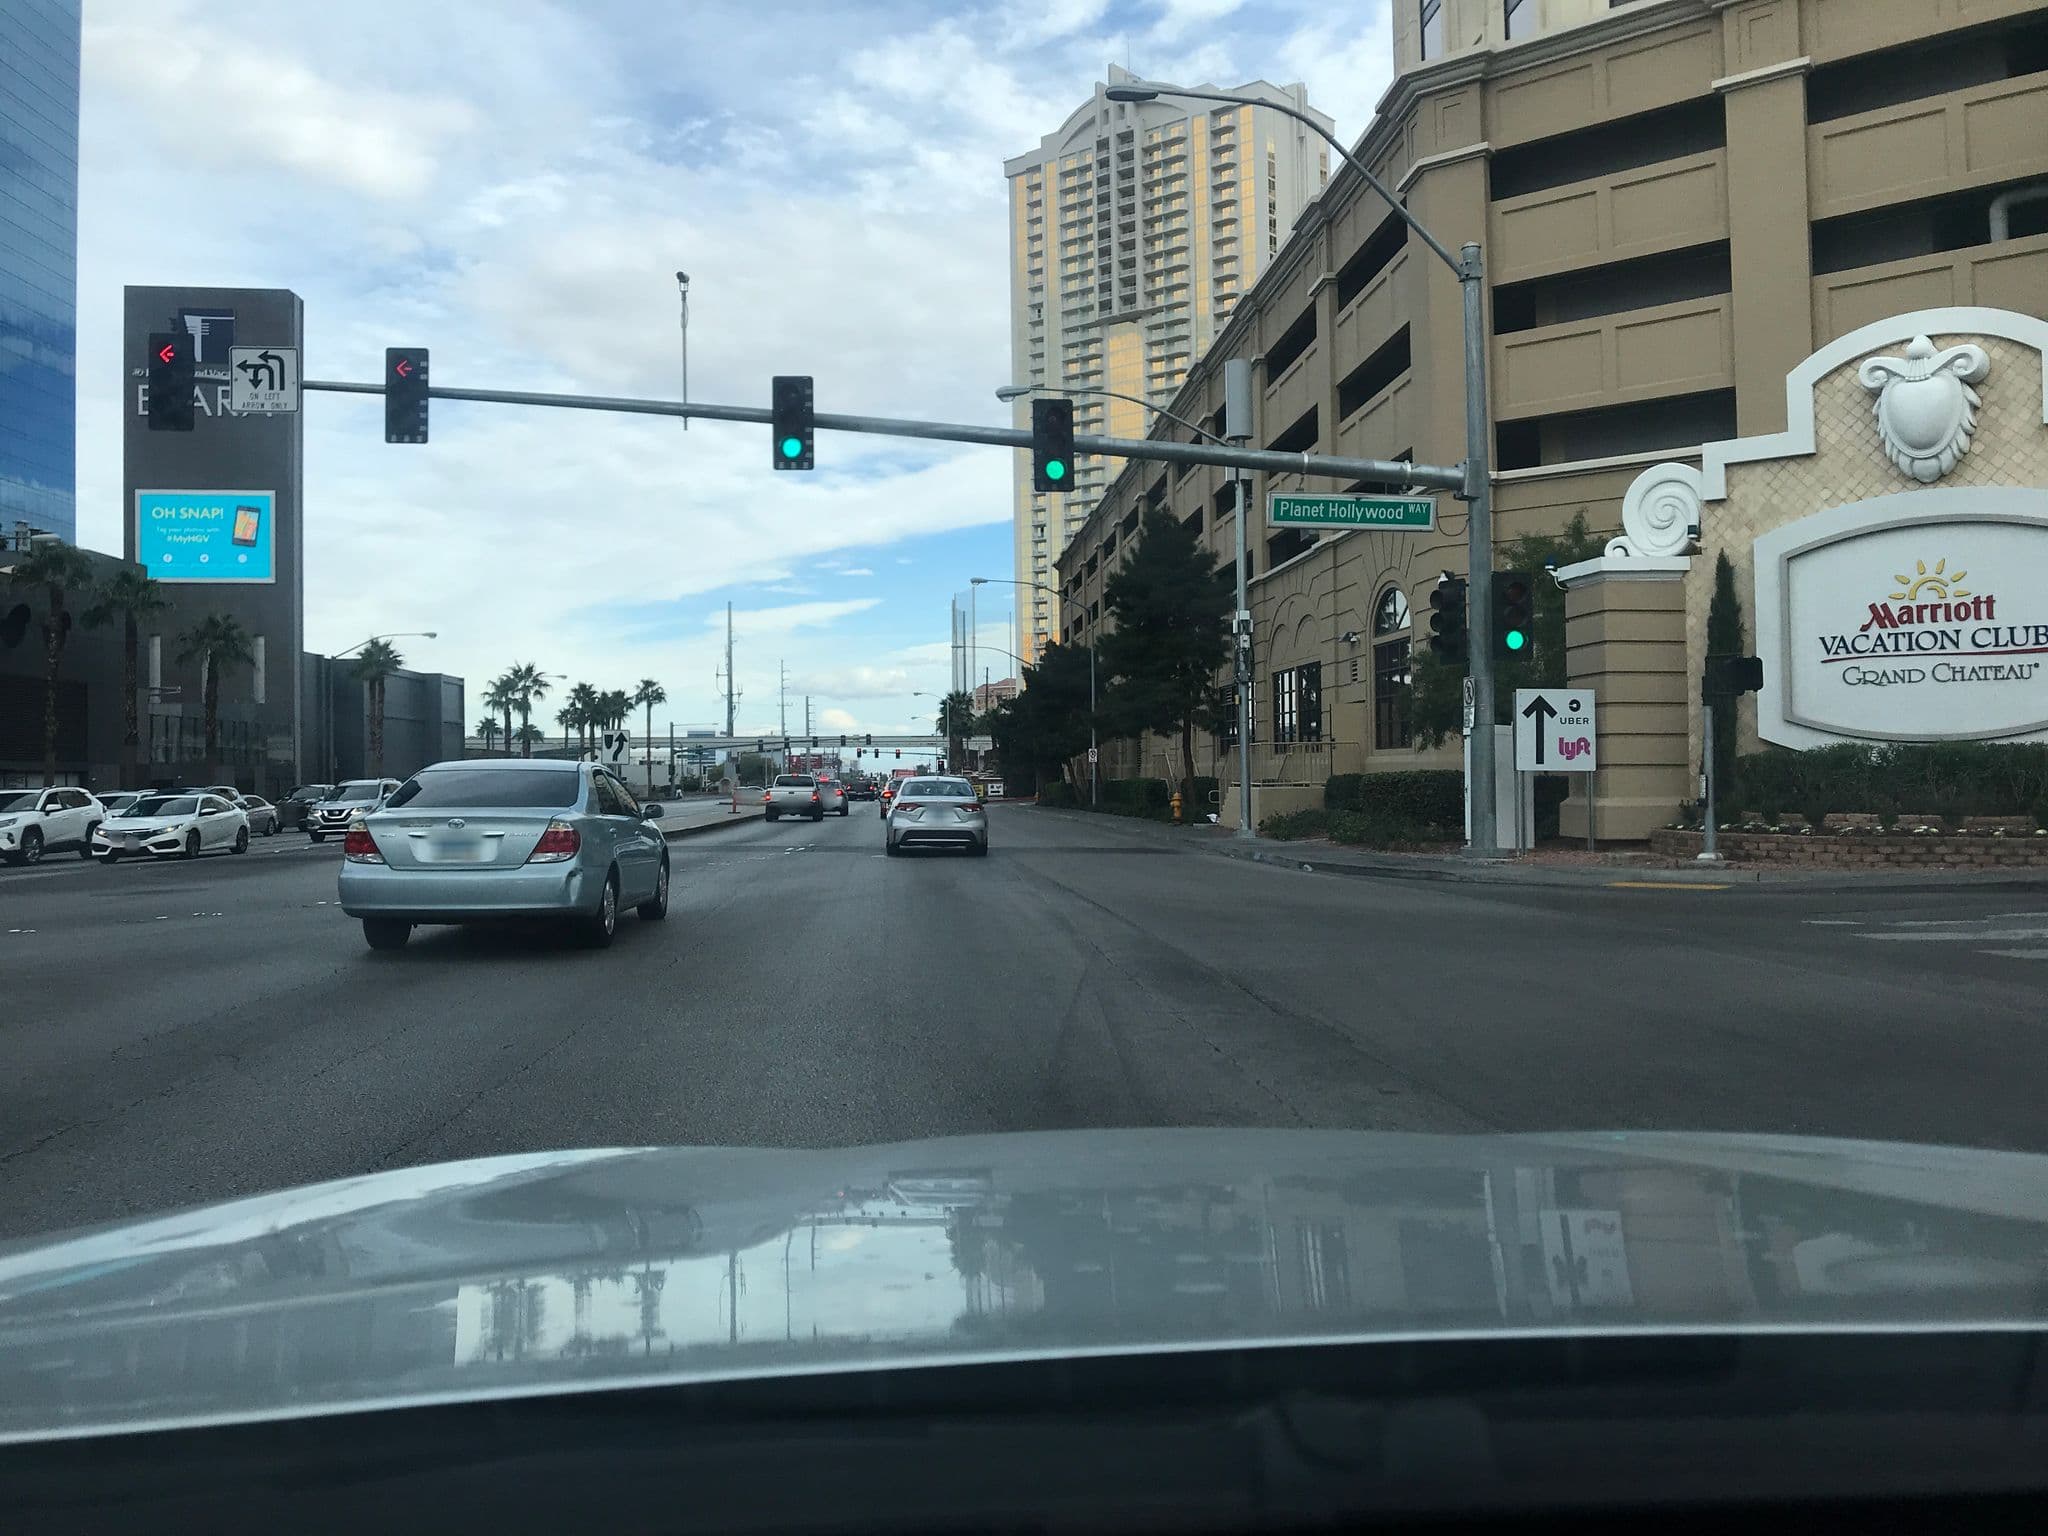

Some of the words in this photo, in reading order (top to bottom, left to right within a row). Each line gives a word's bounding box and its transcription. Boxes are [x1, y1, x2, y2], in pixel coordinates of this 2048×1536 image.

[242, 401, 265, 409] ARROW
[270, 401, 288, 409] ONLY
[264, 392, 280, 400] LEFT
[151, 506, 176, 519] OH
[179, 507, 224, 519] SNAP!
[1280, 501, 1324, 517] Planet
[1329, 502, 1403, 522] Hollywood
[1408, 503, 1428, 513] WAY
[1860, 595, 1996, 631] Marriott
[1819, 629, 1961, 655] VACATION
[1971, 625, 2048, 648] CLUB
[1842, 666, 1926, 686] GRAND
